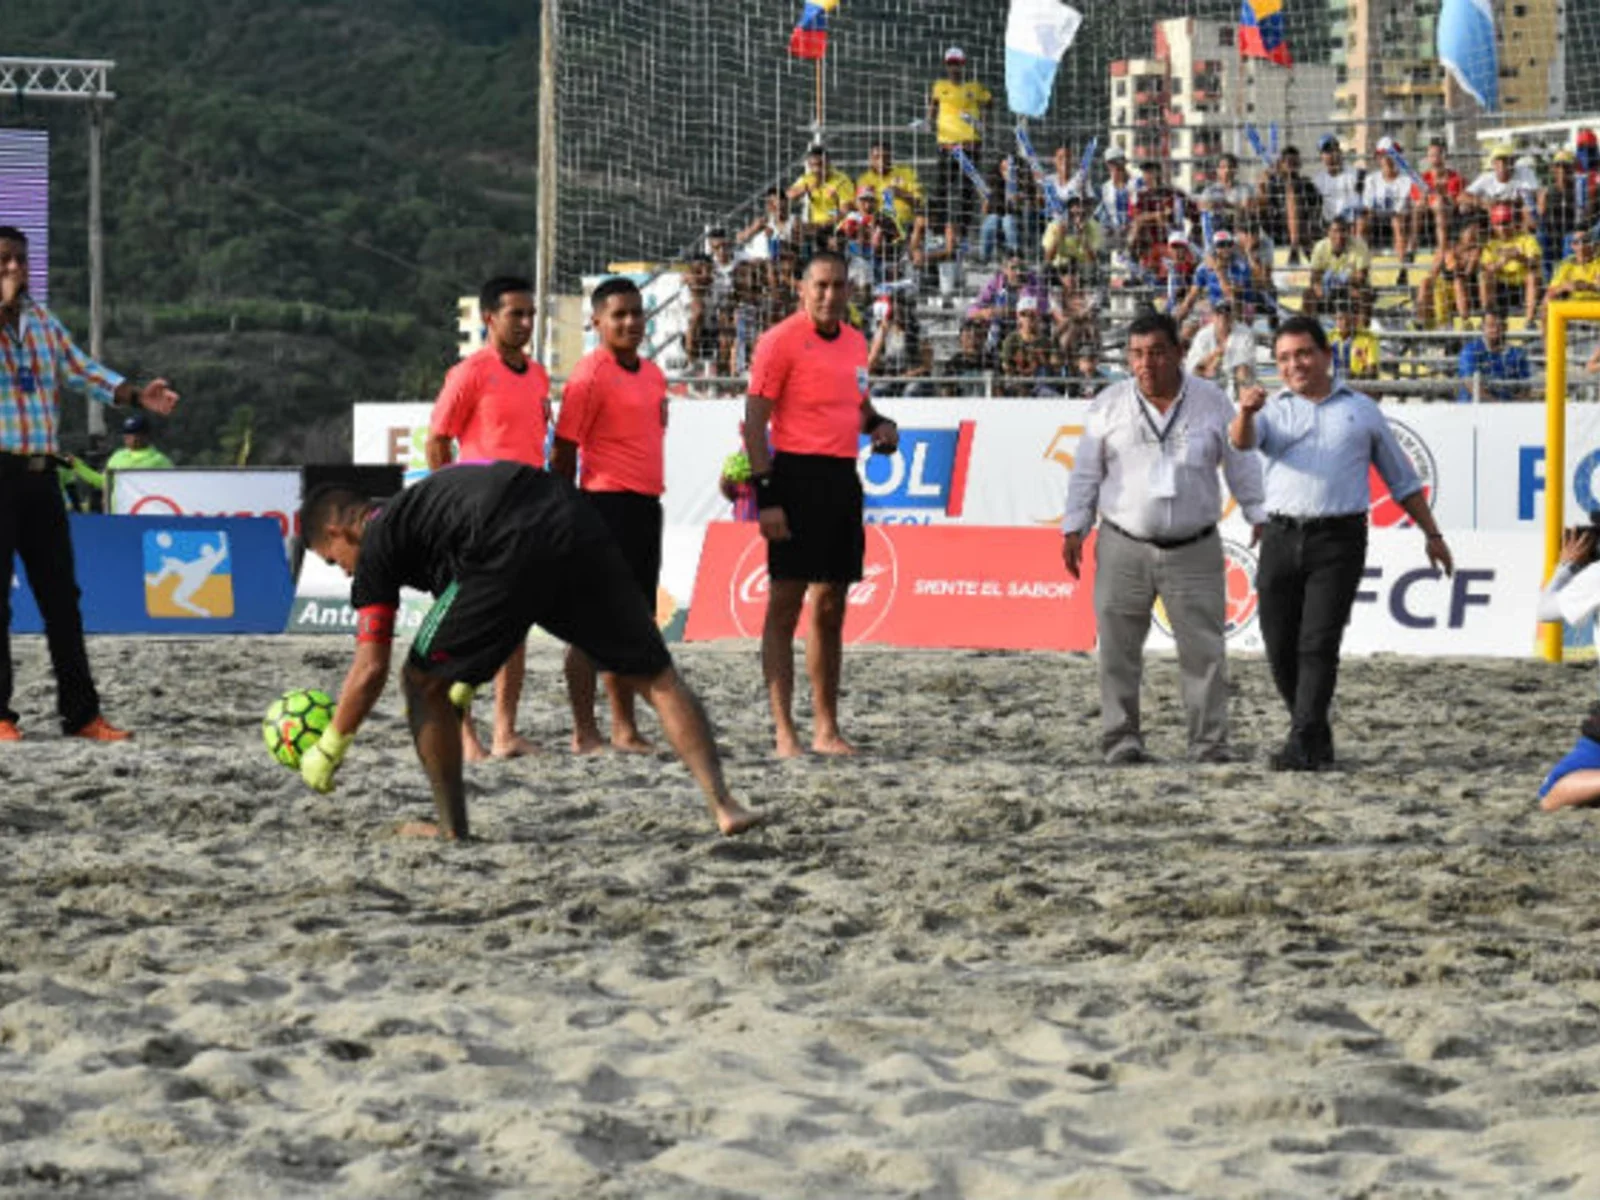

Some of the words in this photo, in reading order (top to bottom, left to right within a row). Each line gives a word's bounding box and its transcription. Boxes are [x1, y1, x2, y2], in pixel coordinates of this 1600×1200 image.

[915, 579, 978, 596] SIENTE
[980, 580, 1002, 596] EL
[1007, 582, 1074, 599] SABOR
